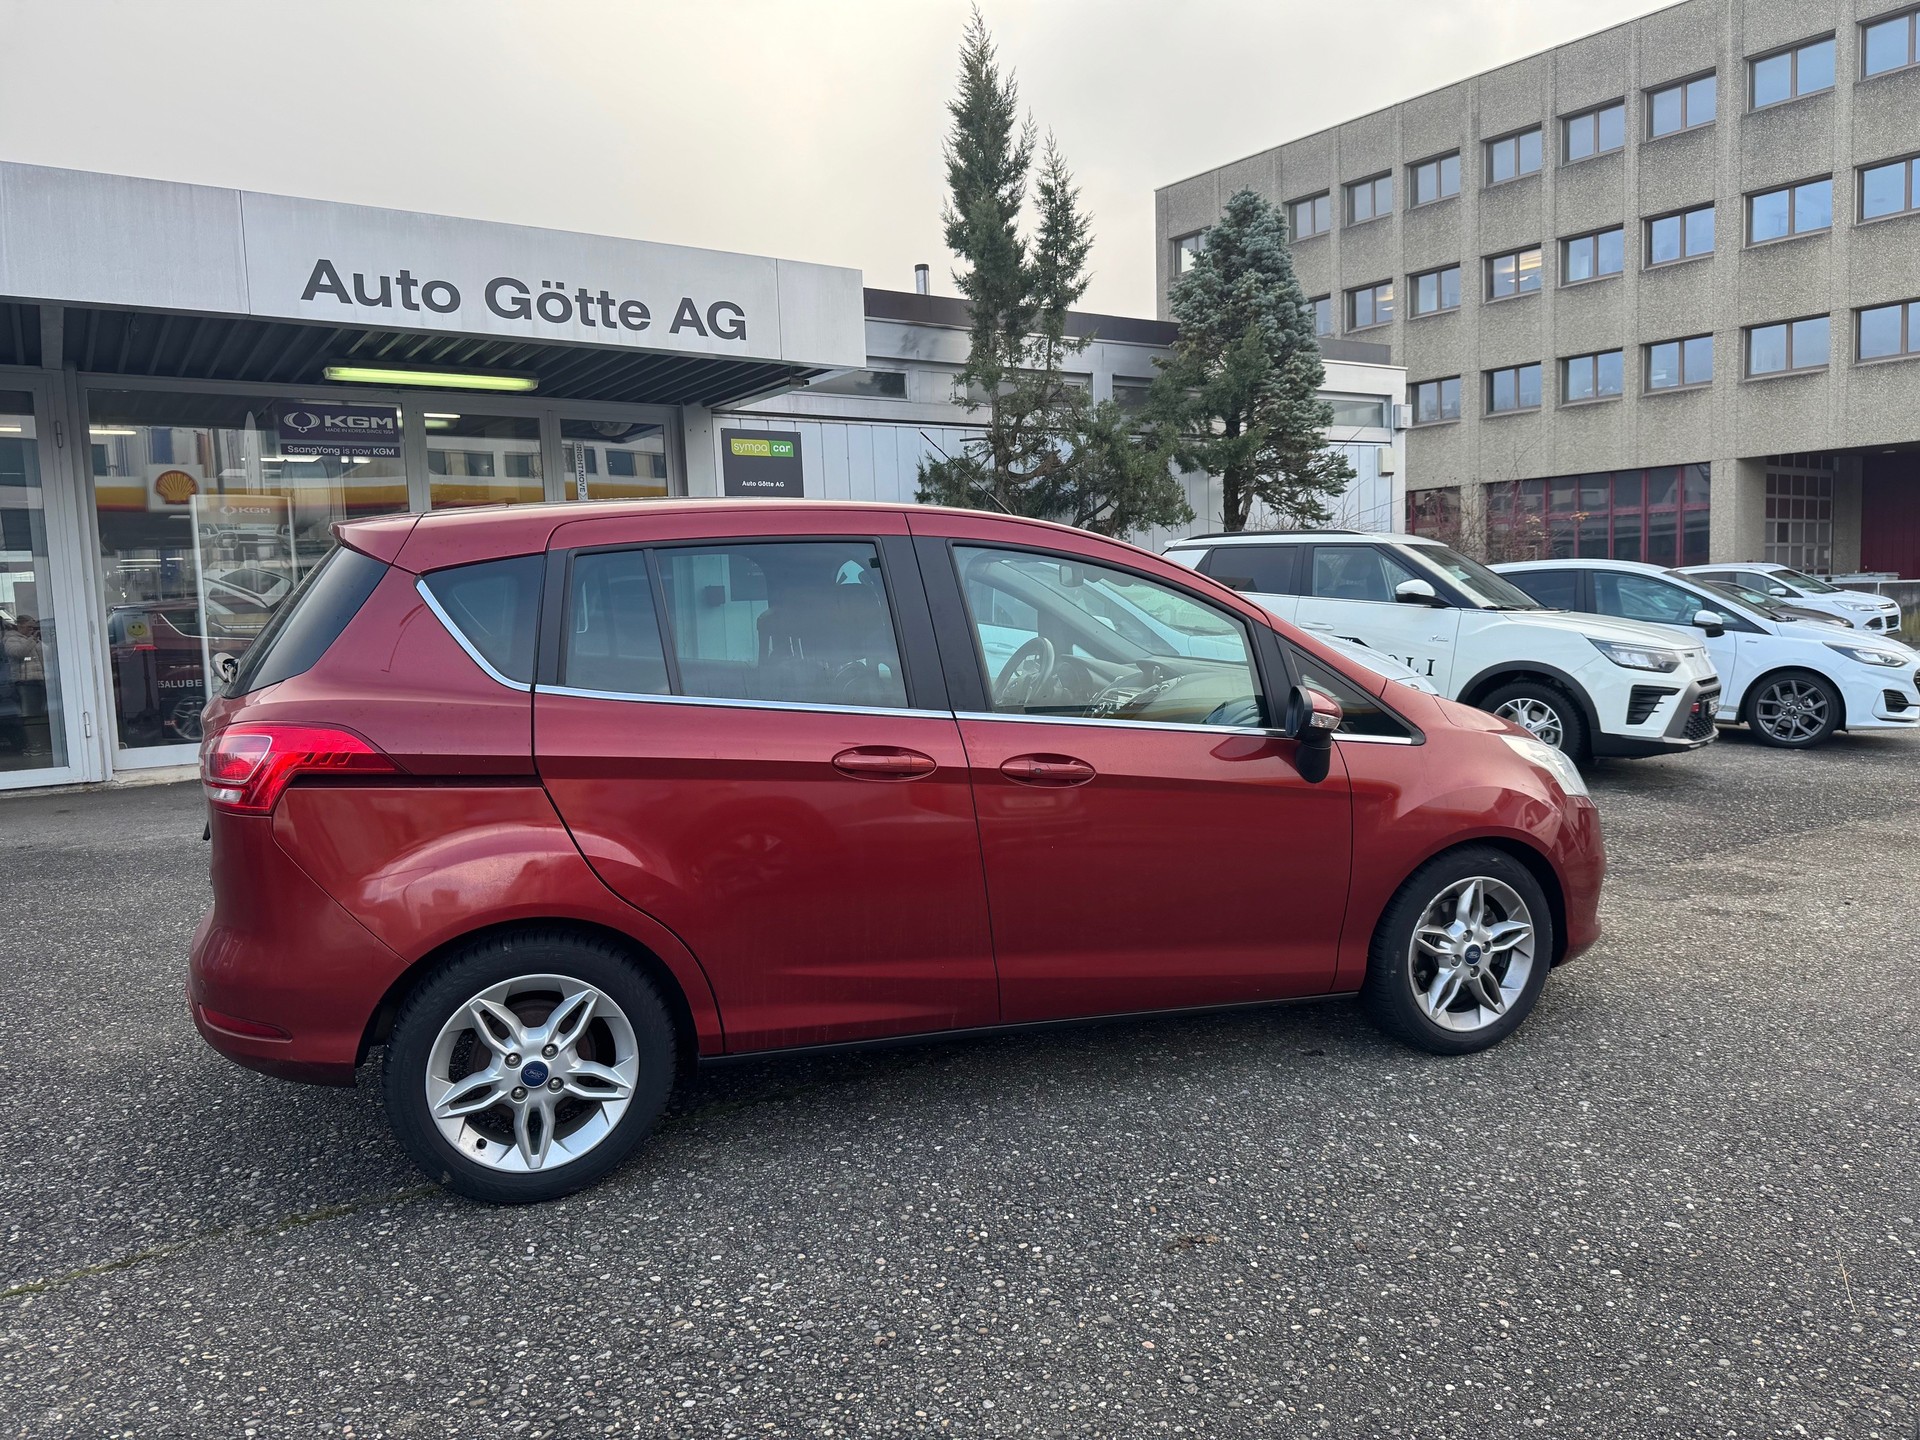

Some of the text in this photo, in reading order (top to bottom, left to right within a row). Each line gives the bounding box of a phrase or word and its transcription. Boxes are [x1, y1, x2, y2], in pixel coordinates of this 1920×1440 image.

[300, 258, 747, 341] Auto Götte AG
[324, 415, 393, 429] KGM
[287, 445, 340, 455] SsangYong
[342, 446, 350, 454] is
[372, 447, 395, 455] KGM
[733, 442, 791, 453] sympa car
[238, 506, 271, 514] KGM
